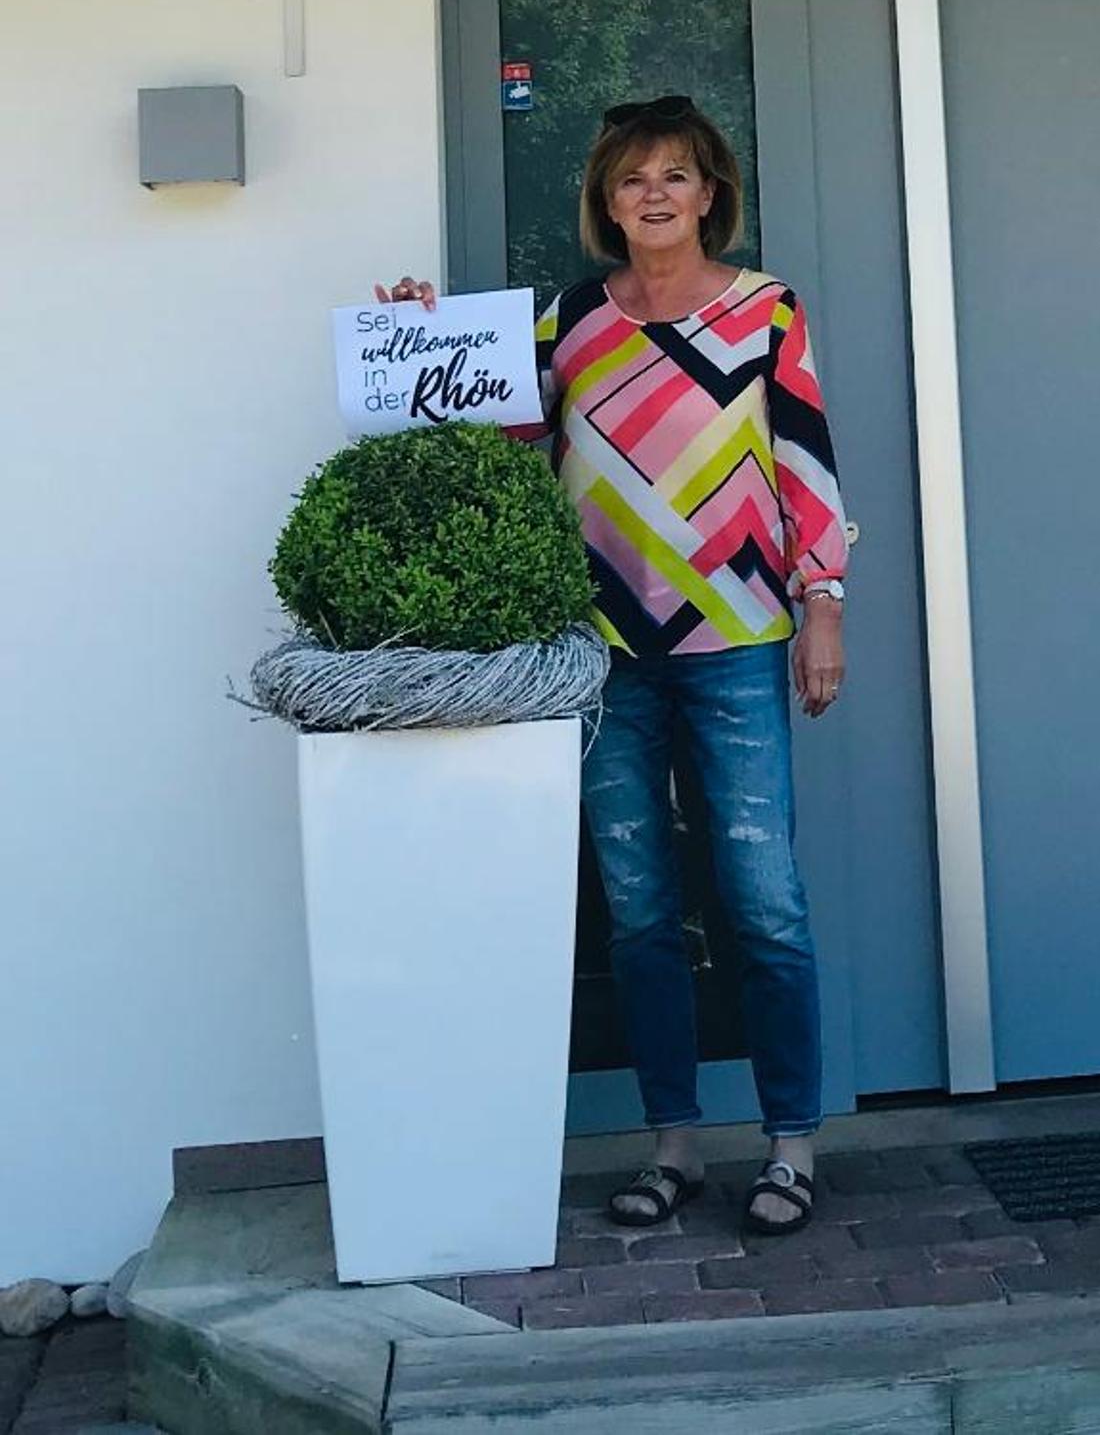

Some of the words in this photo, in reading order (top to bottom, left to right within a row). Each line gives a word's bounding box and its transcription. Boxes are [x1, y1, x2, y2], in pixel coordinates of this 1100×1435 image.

[356, 309, 398, 333] Sei
[361, 326, 499, 364] willkommen
[364, 366, 388, 388] in
[364, 387, 409, 413] der
[410, 348, 513, 423] Rhön
